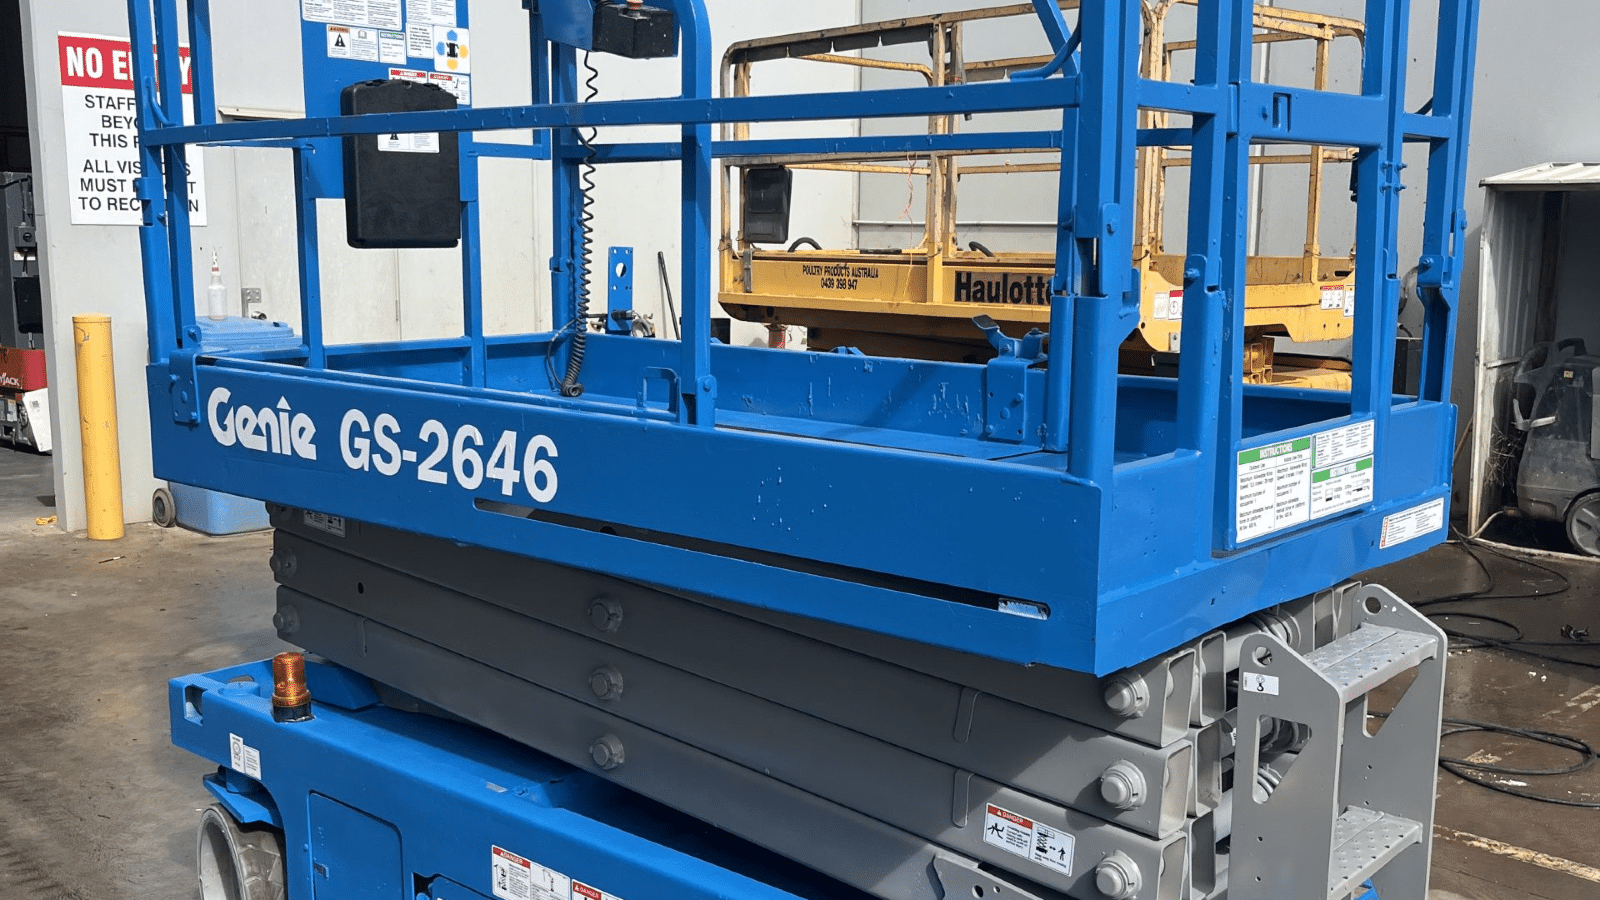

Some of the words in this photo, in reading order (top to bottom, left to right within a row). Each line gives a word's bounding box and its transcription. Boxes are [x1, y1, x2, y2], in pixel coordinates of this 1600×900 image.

[66, 46, 103, 79] NO
[84, 94, 136, 110] STAFF
[101, 115, 139, 130] BEY
[89, 133, 128, 148] THIS
[83, 159, 114, 174] ALL
[118, 160, 191, 176] VISS
[80, 178, 126, 192] MUST
[78, 197, 102, 211] TO
[802, 264, 823, 276] POULTRY
[207, 386, 317, 461] Genie
[339, 408, 559, 503] GS-2646
